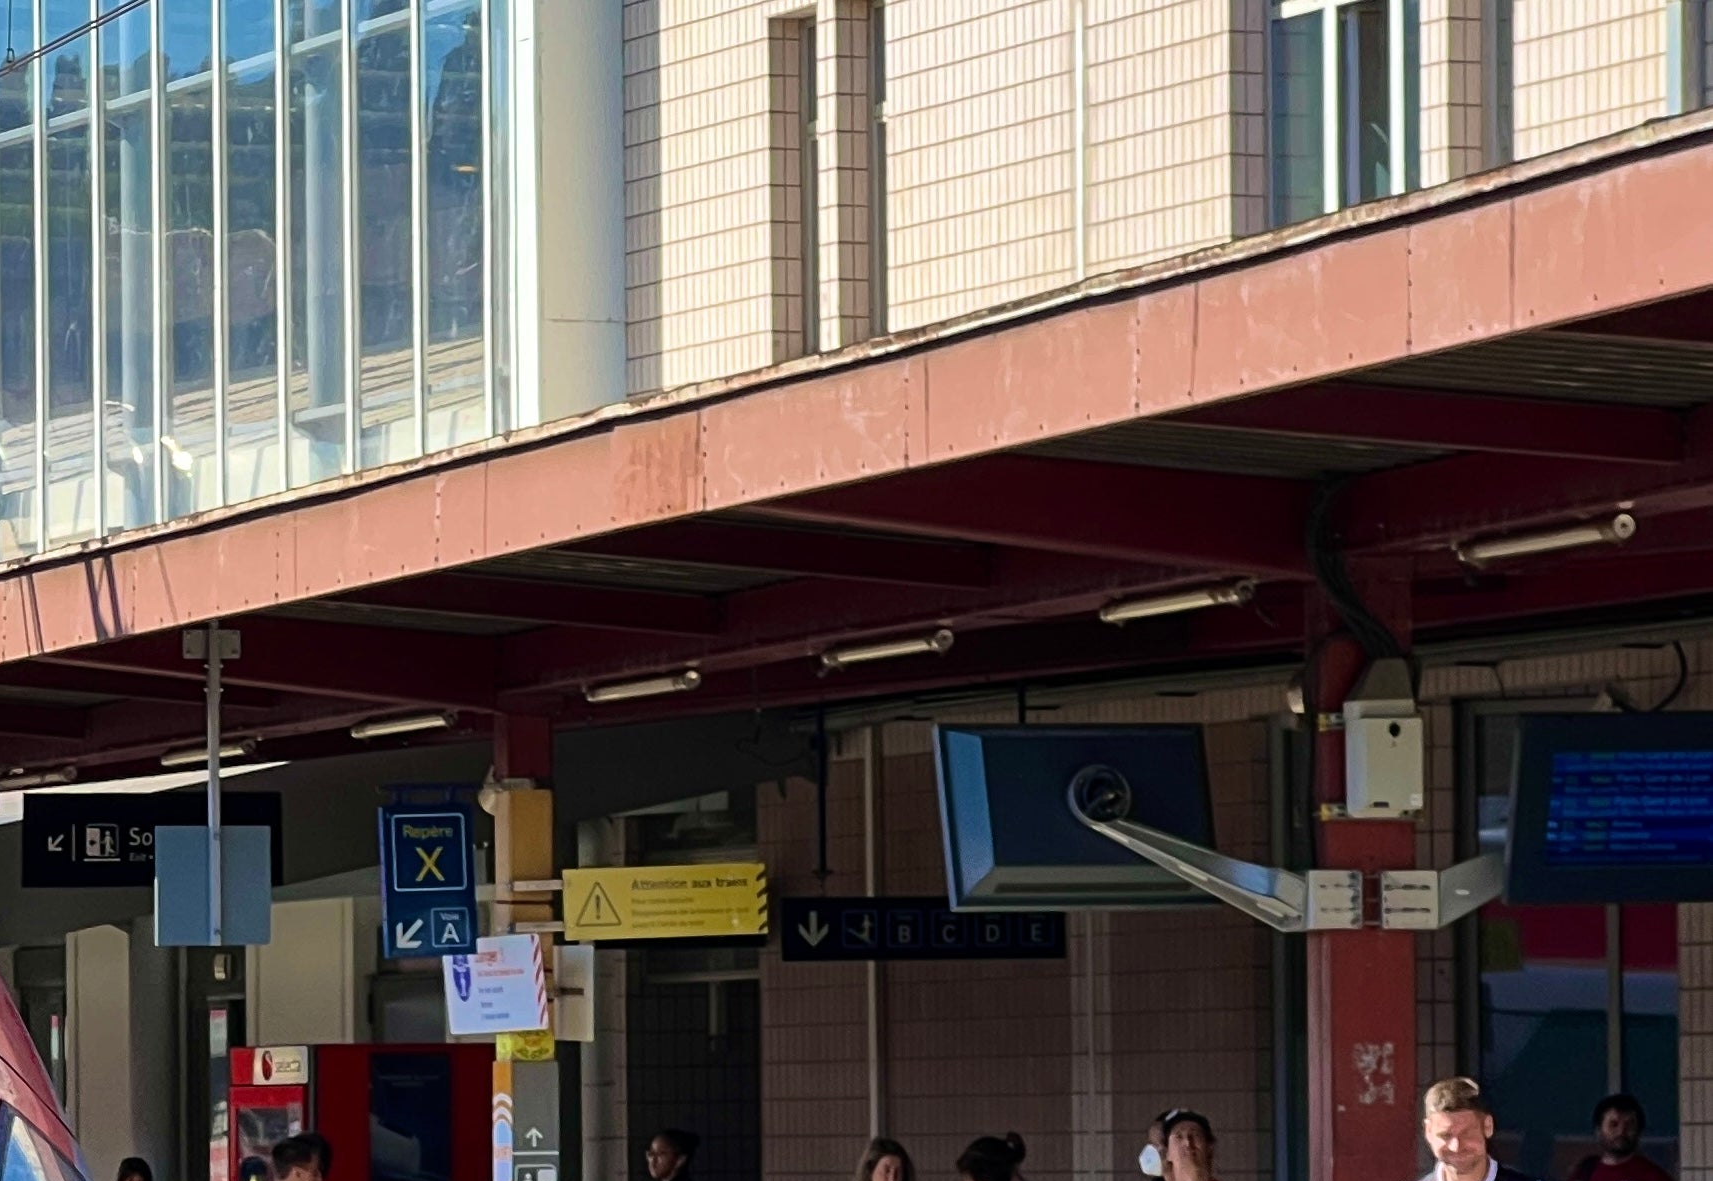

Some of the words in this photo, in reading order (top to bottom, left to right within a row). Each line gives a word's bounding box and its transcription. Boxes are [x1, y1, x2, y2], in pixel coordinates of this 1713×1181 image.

[415, 846, 445, 882] X
[631, 878, 687, 890] Attention
[692, 879, 712, 889] aux
[716, 877, 749, 888] trains
[441, 923, 461, 944] A
[898, 925, 911, 942] B
[942, 925, 957, 942] C
[986, 925, 1000, 942] D
[1030, 923, 1043, 942] E
